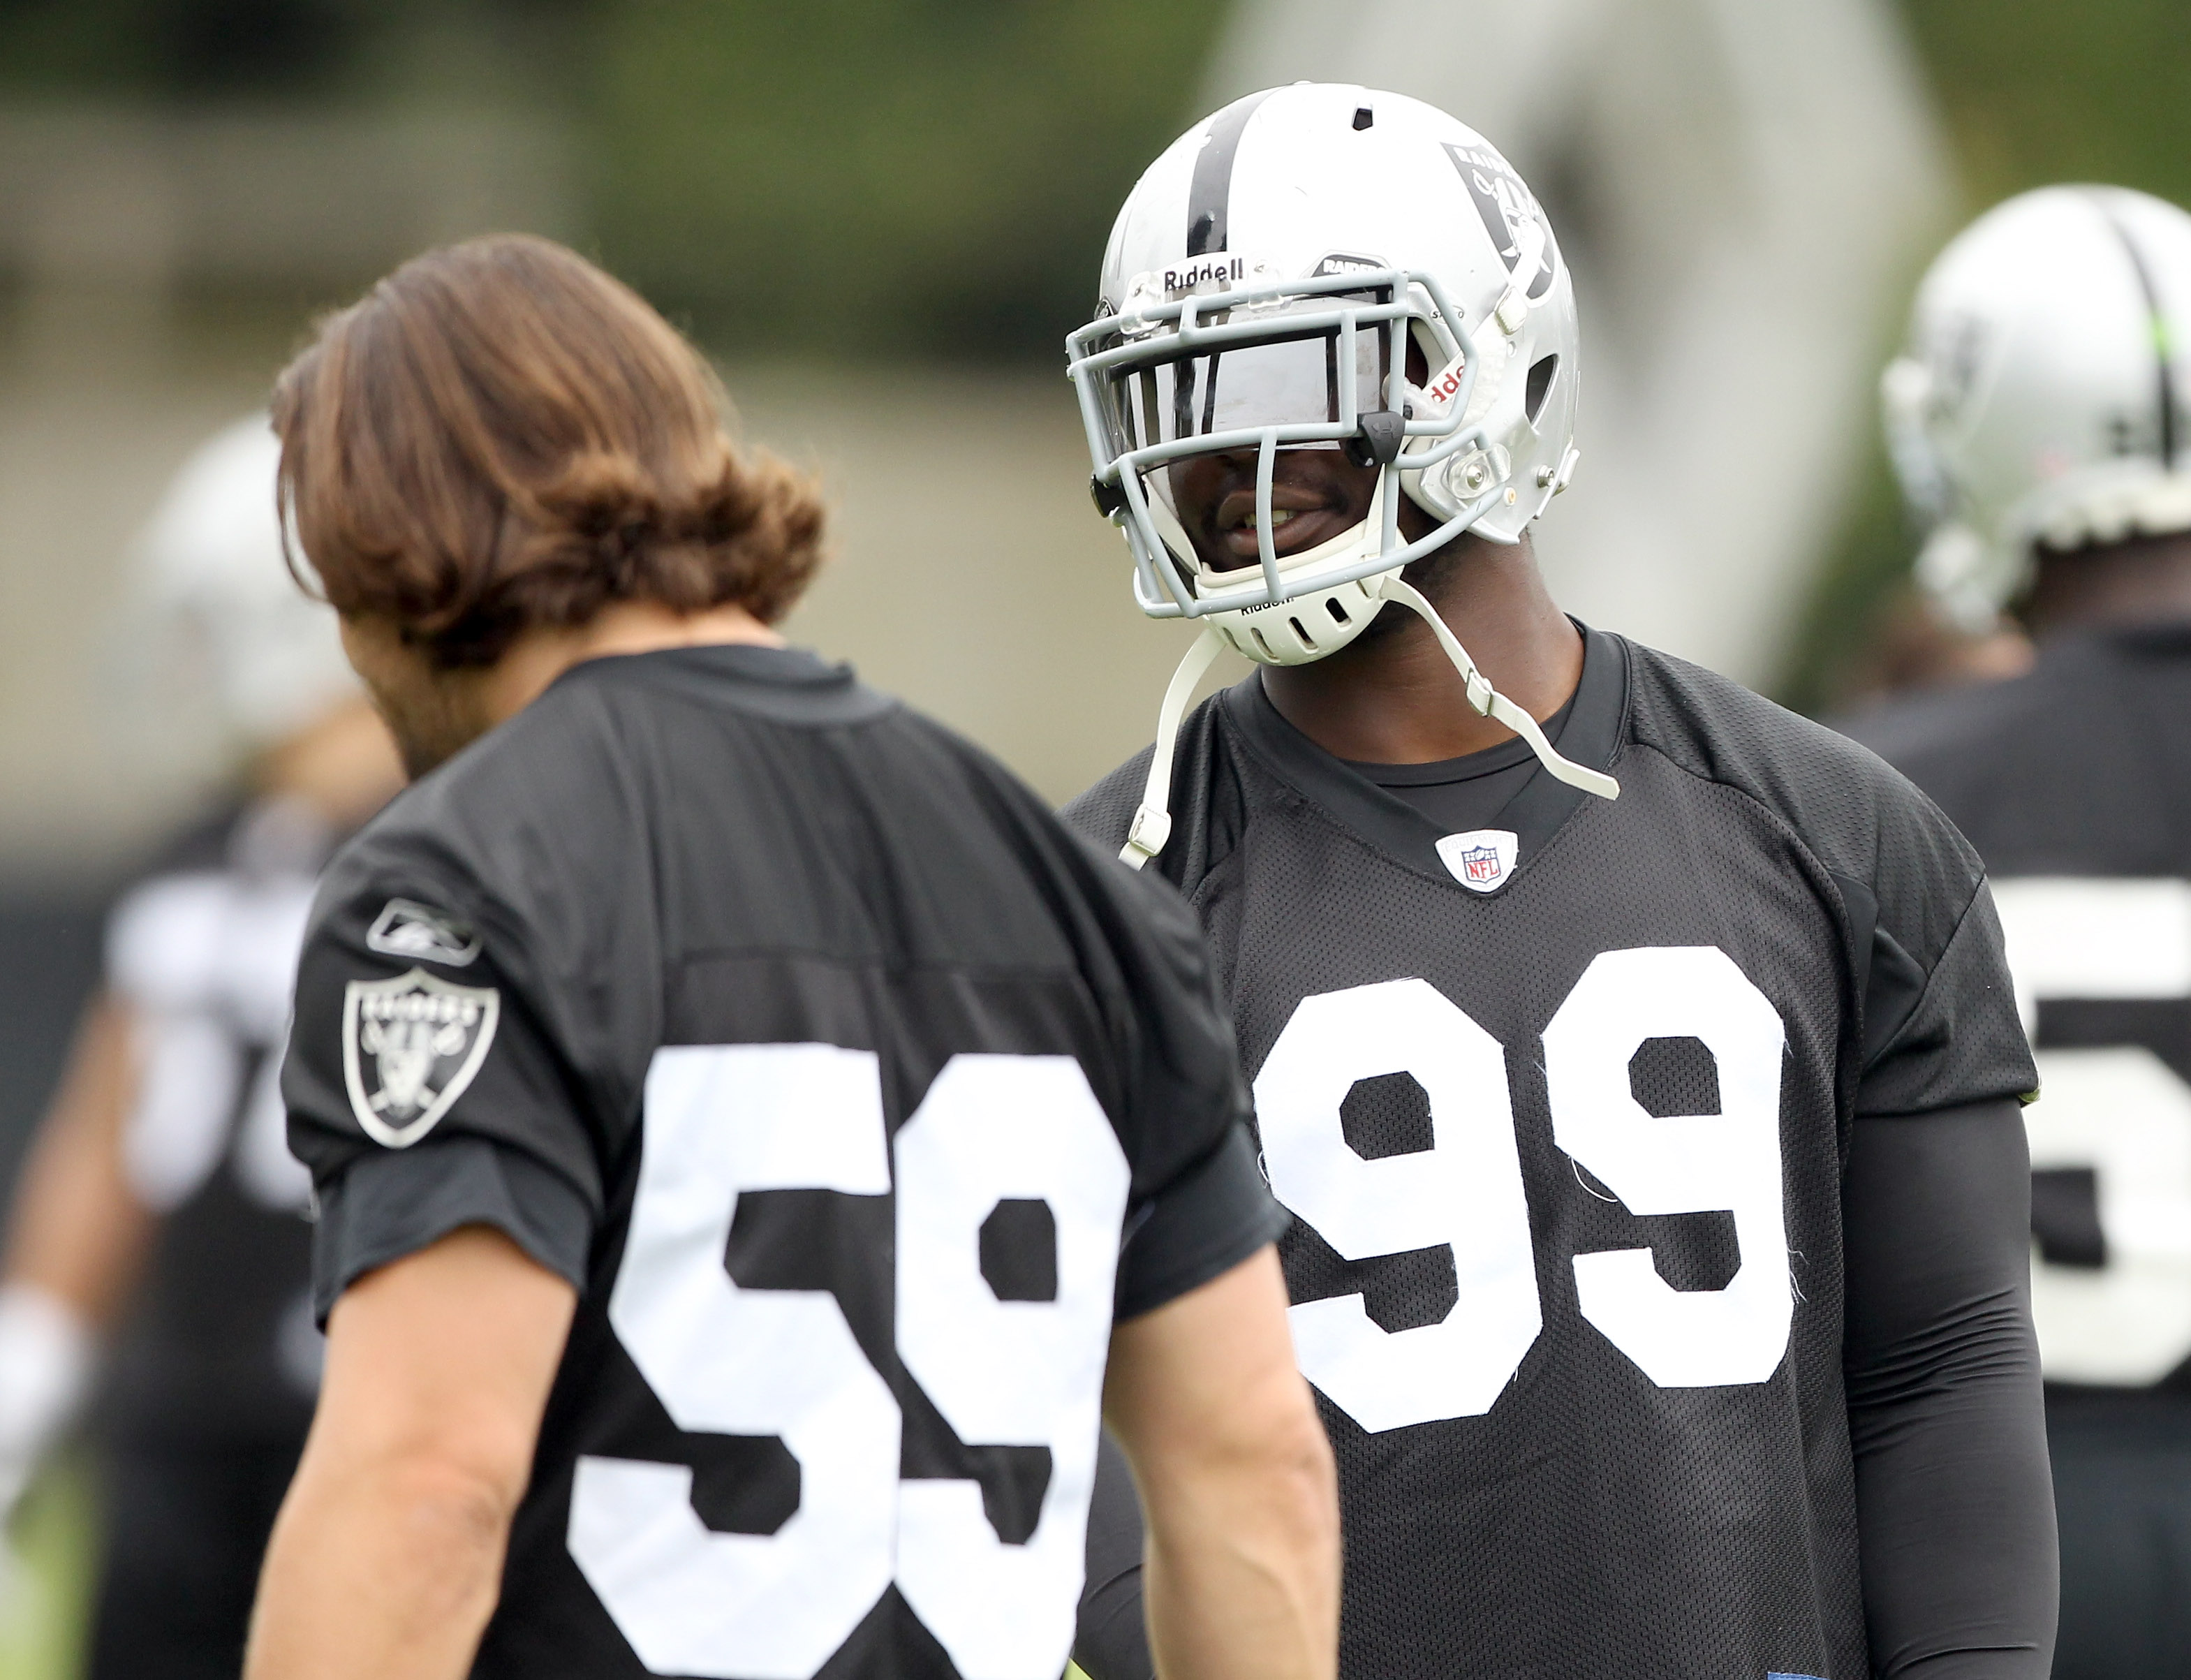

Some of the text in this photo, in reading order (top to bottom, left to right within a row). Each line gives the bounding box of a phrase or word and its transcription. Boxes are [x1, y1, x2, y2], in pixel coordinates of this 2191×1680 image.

[1165, 258, 1243, 292] Riddell
[1468, 860, 1499, 878] NFL
[1252, 945, 1796, 1434] 99
[566, 1042, 1133, 1680] 59
